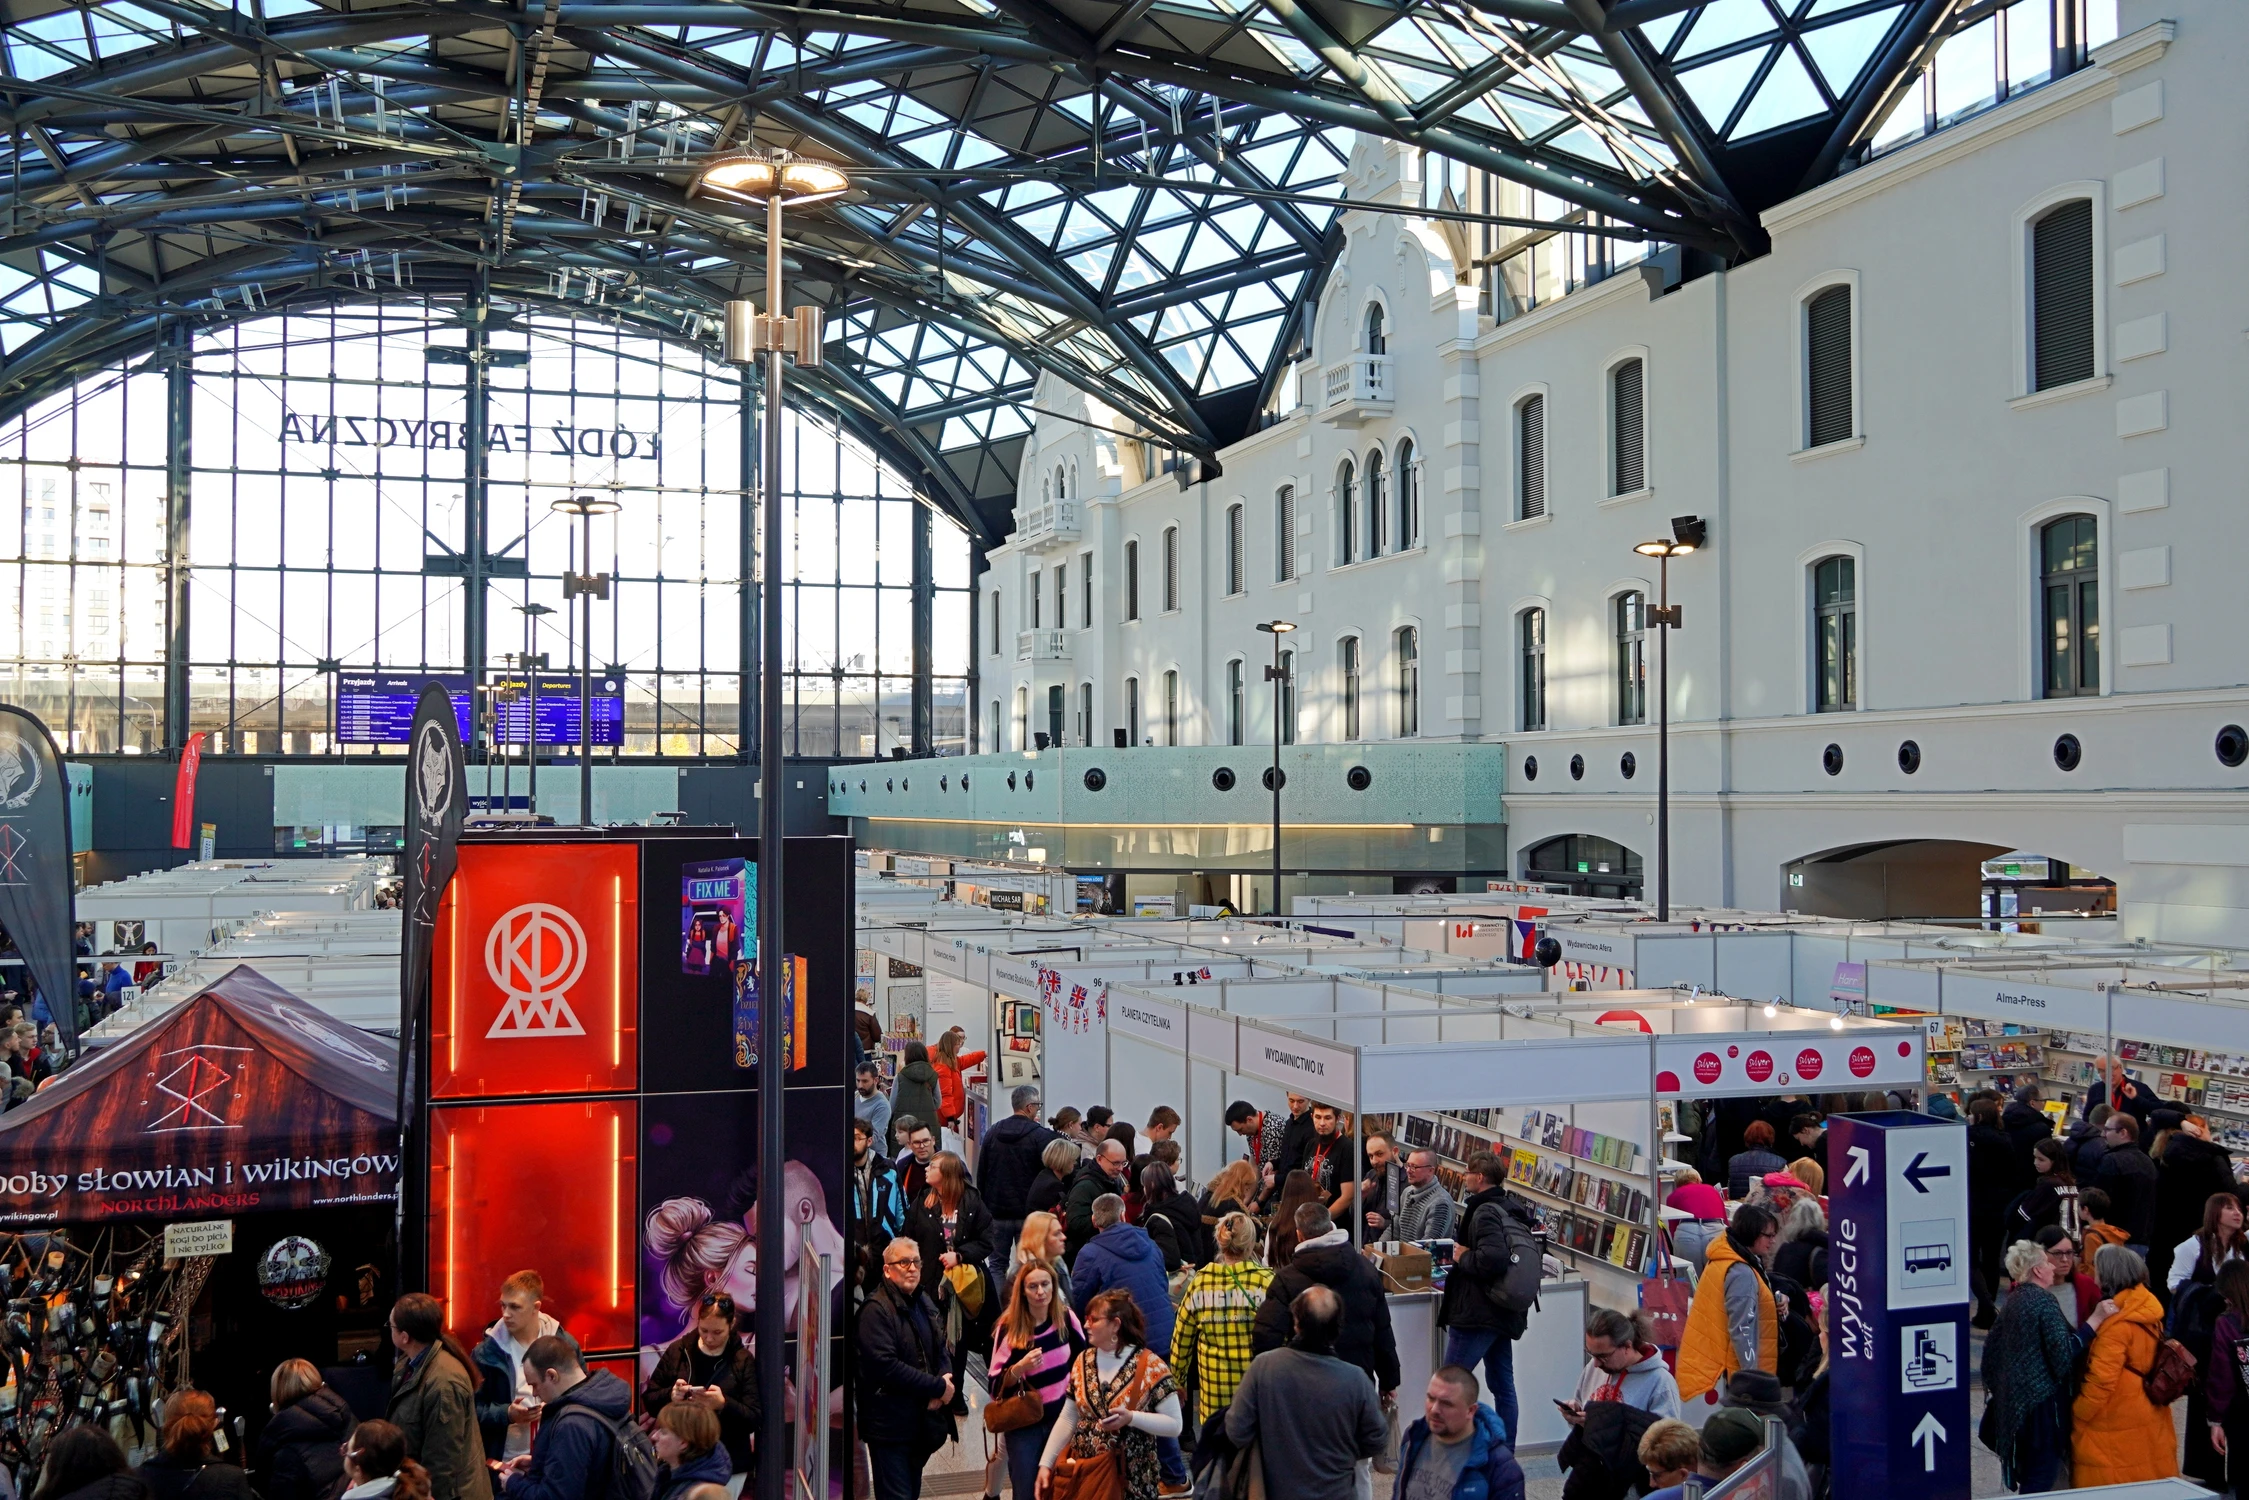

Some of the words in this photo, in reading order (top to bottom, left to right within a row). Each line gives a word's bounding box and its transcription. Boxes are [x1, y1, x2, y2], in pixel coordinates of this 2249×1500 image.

[696, 882, 712, 898] FIX
[714, 881, 730, 897] ME
[1567, 939, 1598, 950] Wydawnictwo
[1599, 944, 1612, 952] Afera
[166, 964, 177, 972] 120
[1030, 960, 1038, 968] 95
[1094, 978, 1102, 987] 96
[2098, 983, 2105, 992] 66
[123, 990, 134, 1000] 121
[1996, 992, 2046, 1008] Alma-Press
[1122, 1006, 1141, 1021] PLANETA
[1142, 1012, 1171, 1030] CZYTELNIKA
[1930, 1022, 1939, 1033] 67
[1265, 1047, 1316, 1073] WYDAWNICTWO
[1318, 1062, 1324, 1076] IX
[173, 1224, 224, 1234] NATURALNE
[1841, 1218, 1864, 1358] wyjście
[1863, 1322, 1873, 1361] exit
